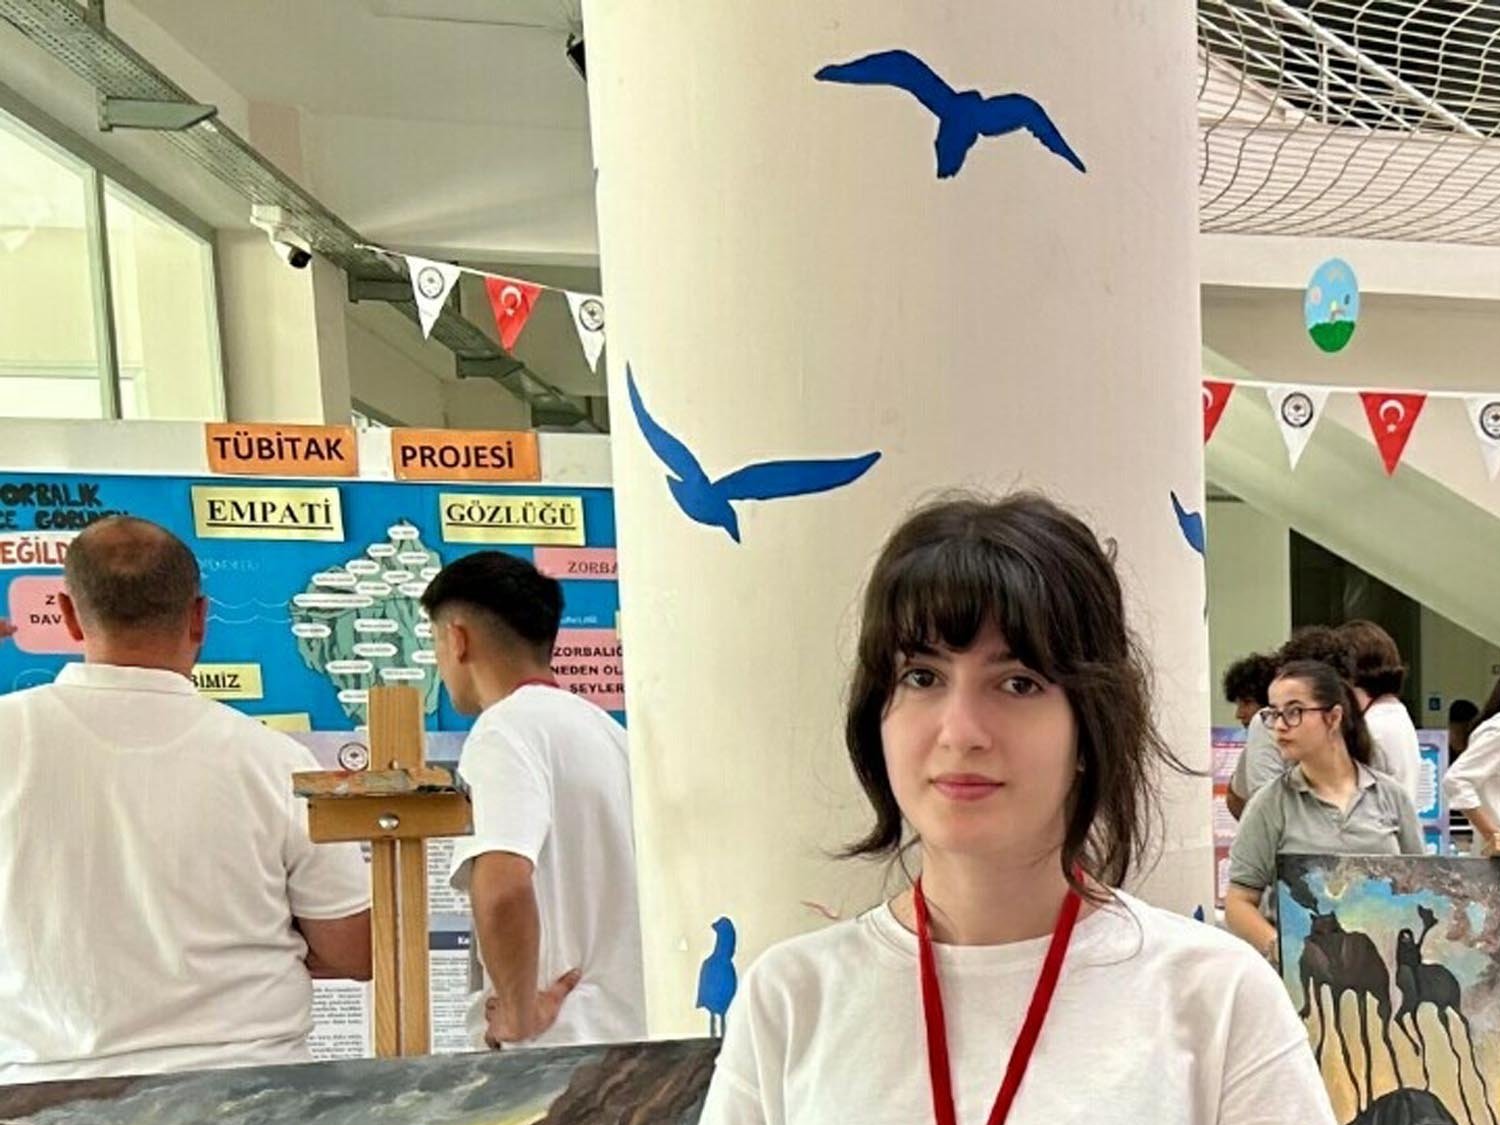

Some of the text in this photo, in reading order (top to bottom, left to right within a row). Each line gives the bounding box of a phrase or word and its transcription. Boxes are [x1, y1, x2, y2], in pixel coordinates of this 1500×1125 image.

[213, 431, 514, 469] TÜBİTAK PROJESİ
[208, 498, 576, 526] EMPATİ GÖZLÜĞÜ
